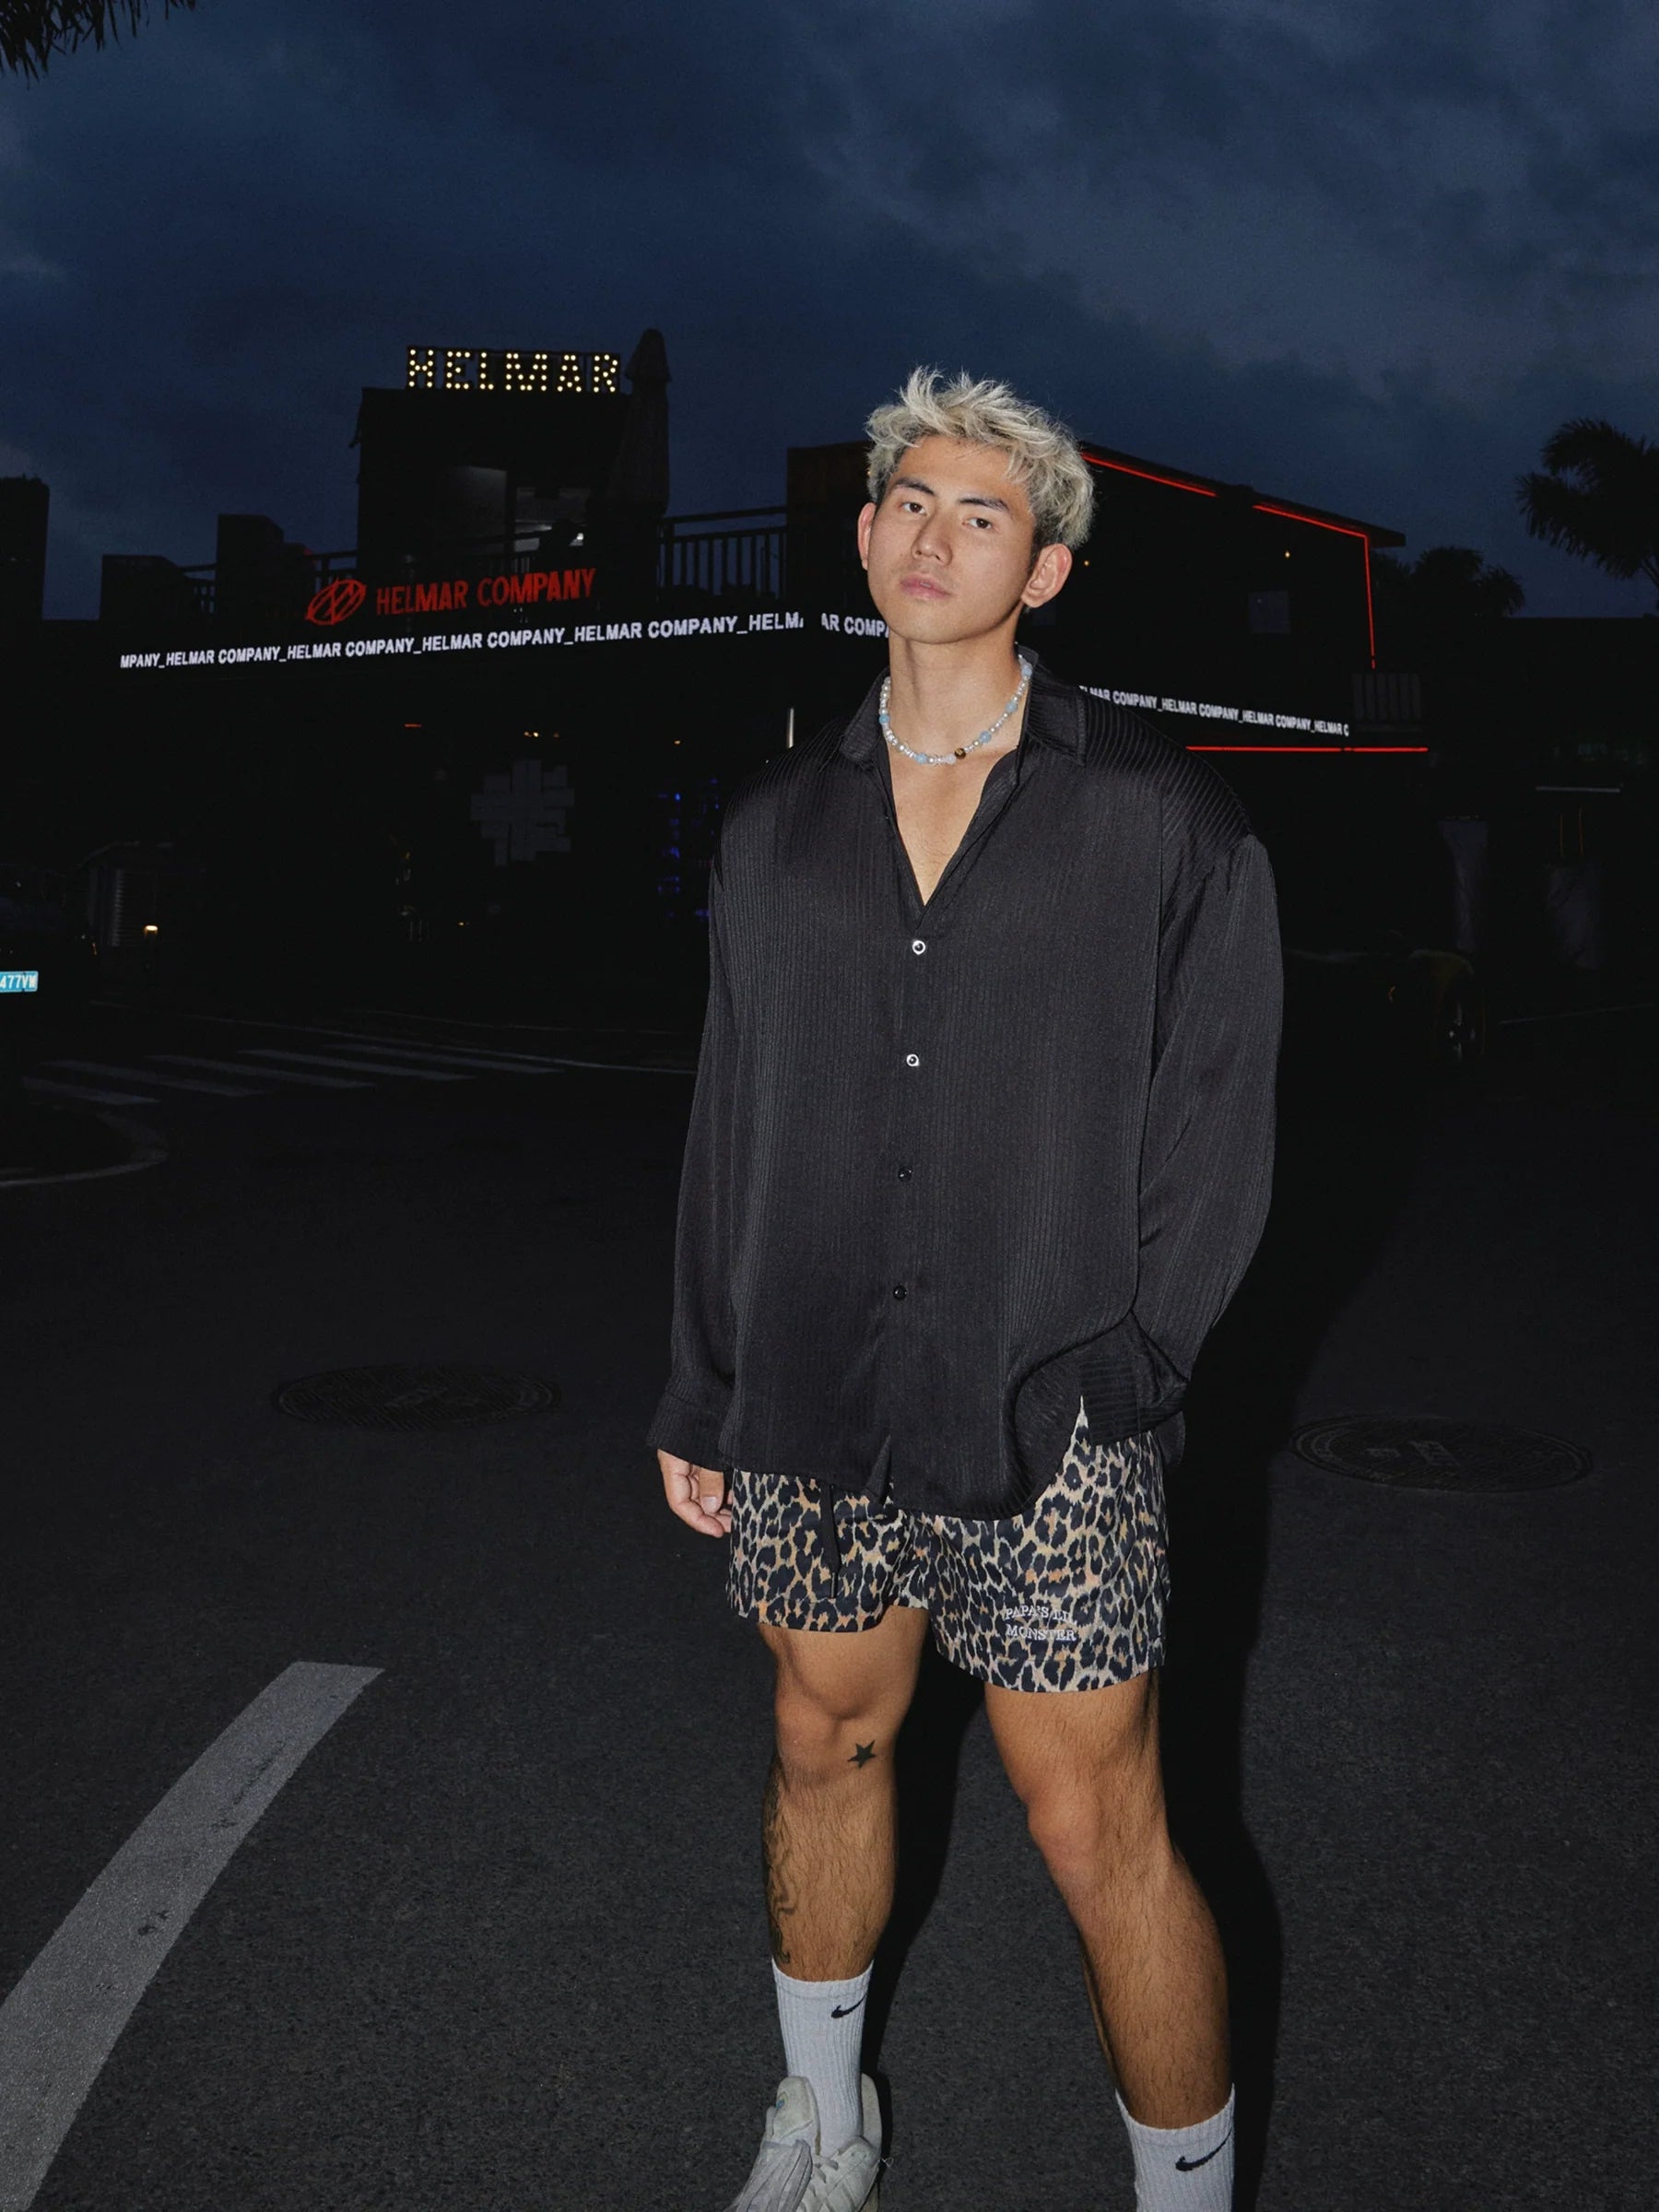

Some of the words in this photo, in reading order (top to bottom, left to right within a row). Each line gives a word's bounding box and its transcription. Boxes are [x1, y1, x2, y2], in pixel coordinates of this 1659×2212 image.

[408, 349, 618, 393] HELMAR
[376, 580, 469, 615] HELMAR
[477, 568, 596, 607] COMPANY
[1006, 1622, 1077, 1642] MONSTER
